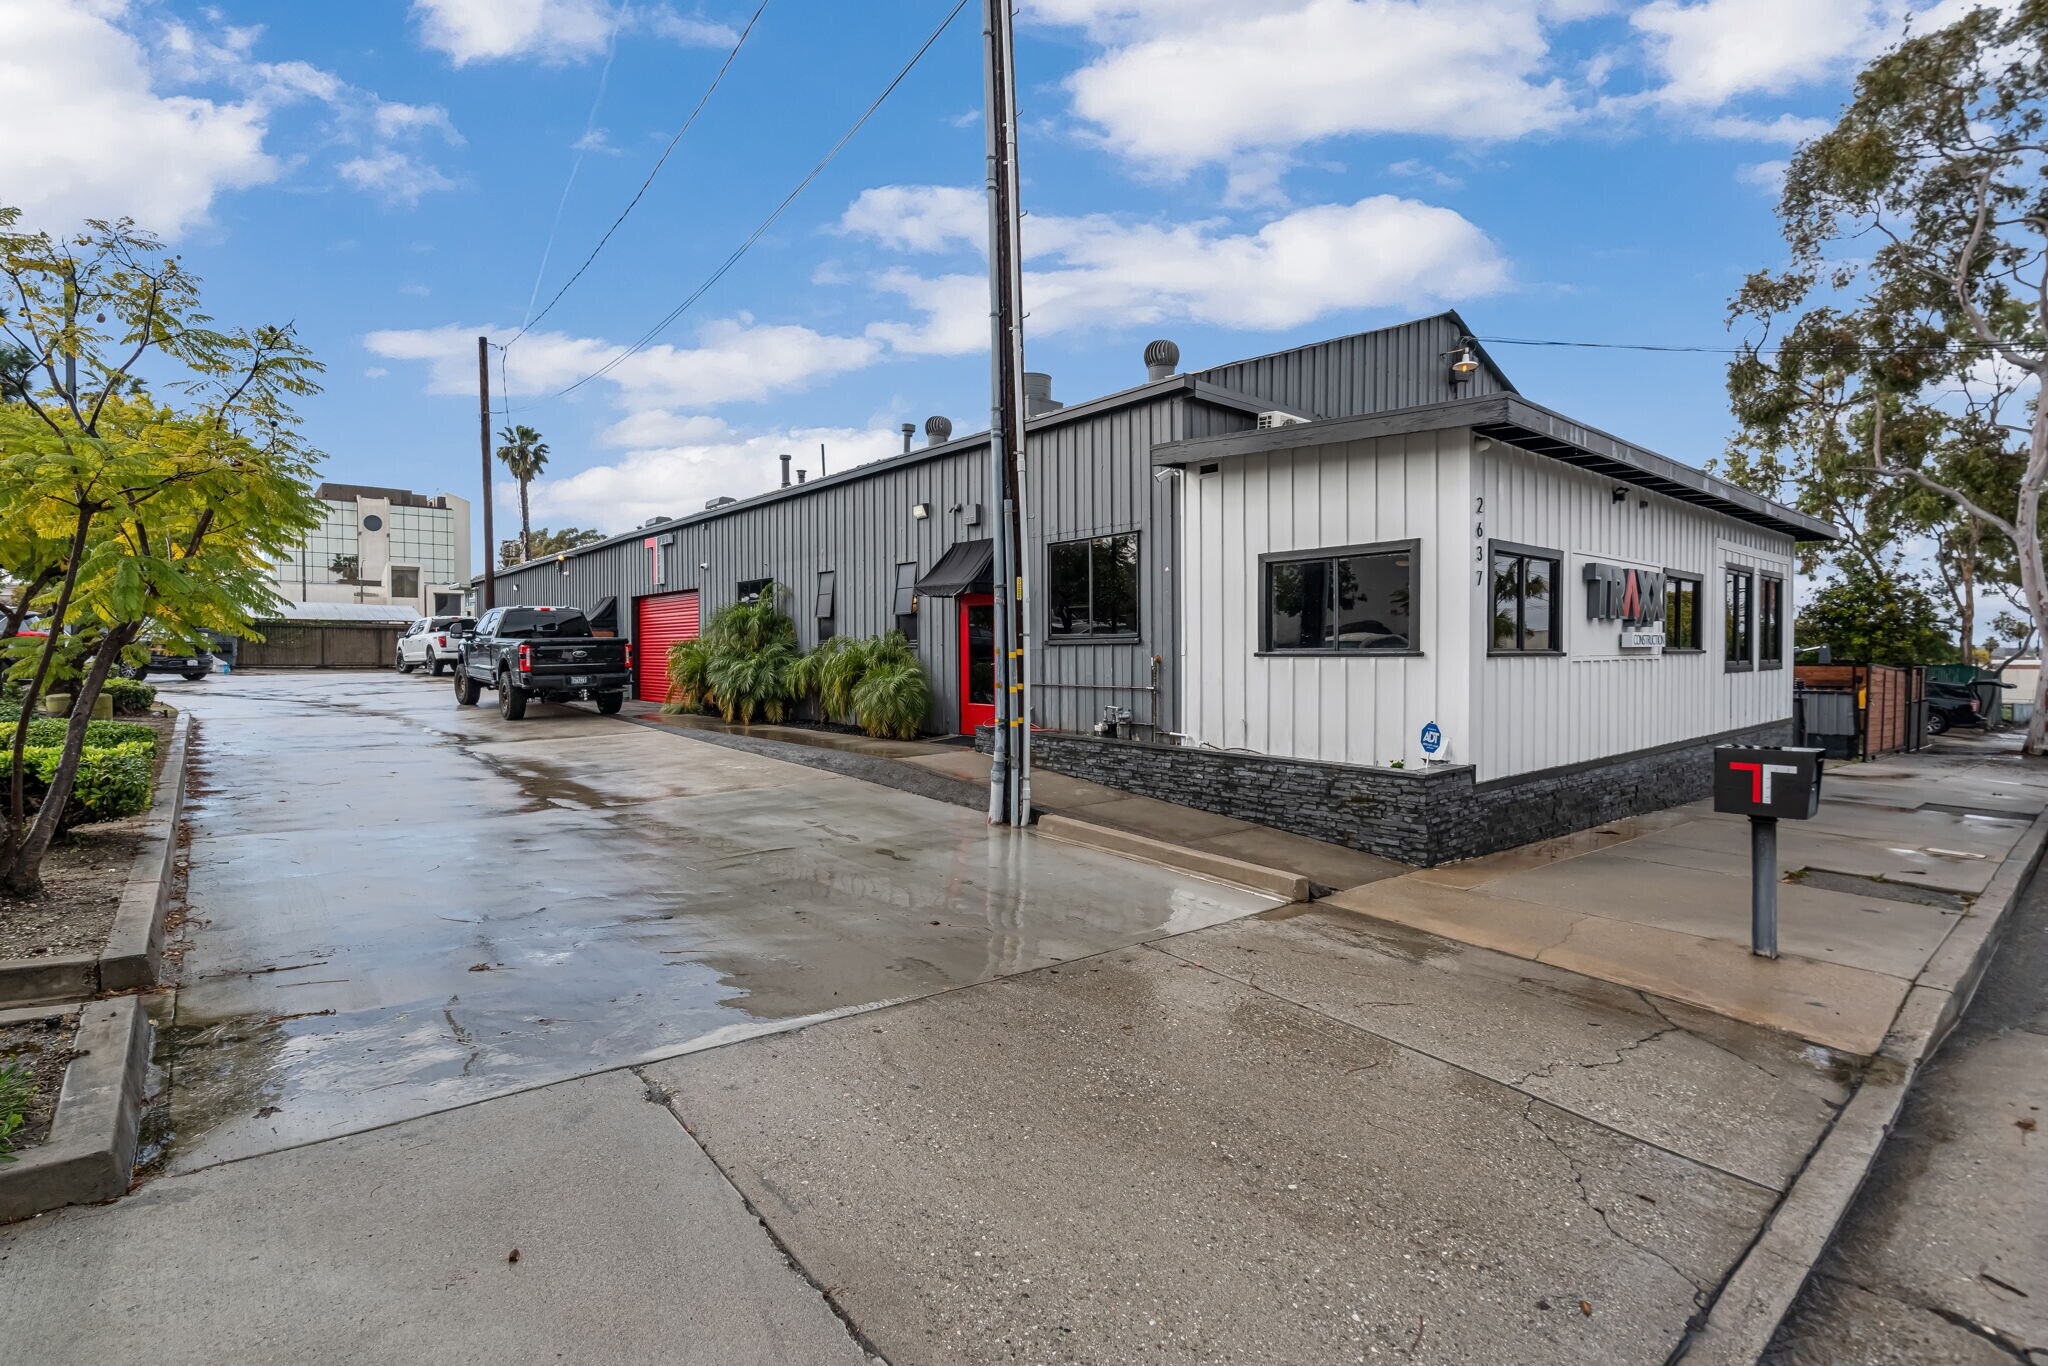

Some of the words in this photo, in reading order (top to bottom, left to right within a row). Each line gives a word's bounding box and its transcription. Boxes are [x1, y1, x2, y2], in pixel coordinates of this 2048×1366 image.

[1476, 496, 1484, 586] 2637
[1585, 562, 1667, 627] TRAXX
[1632, 634, 1666, 646] CONSTRUCTION
[1422, 730, 1440, 744] ADT
